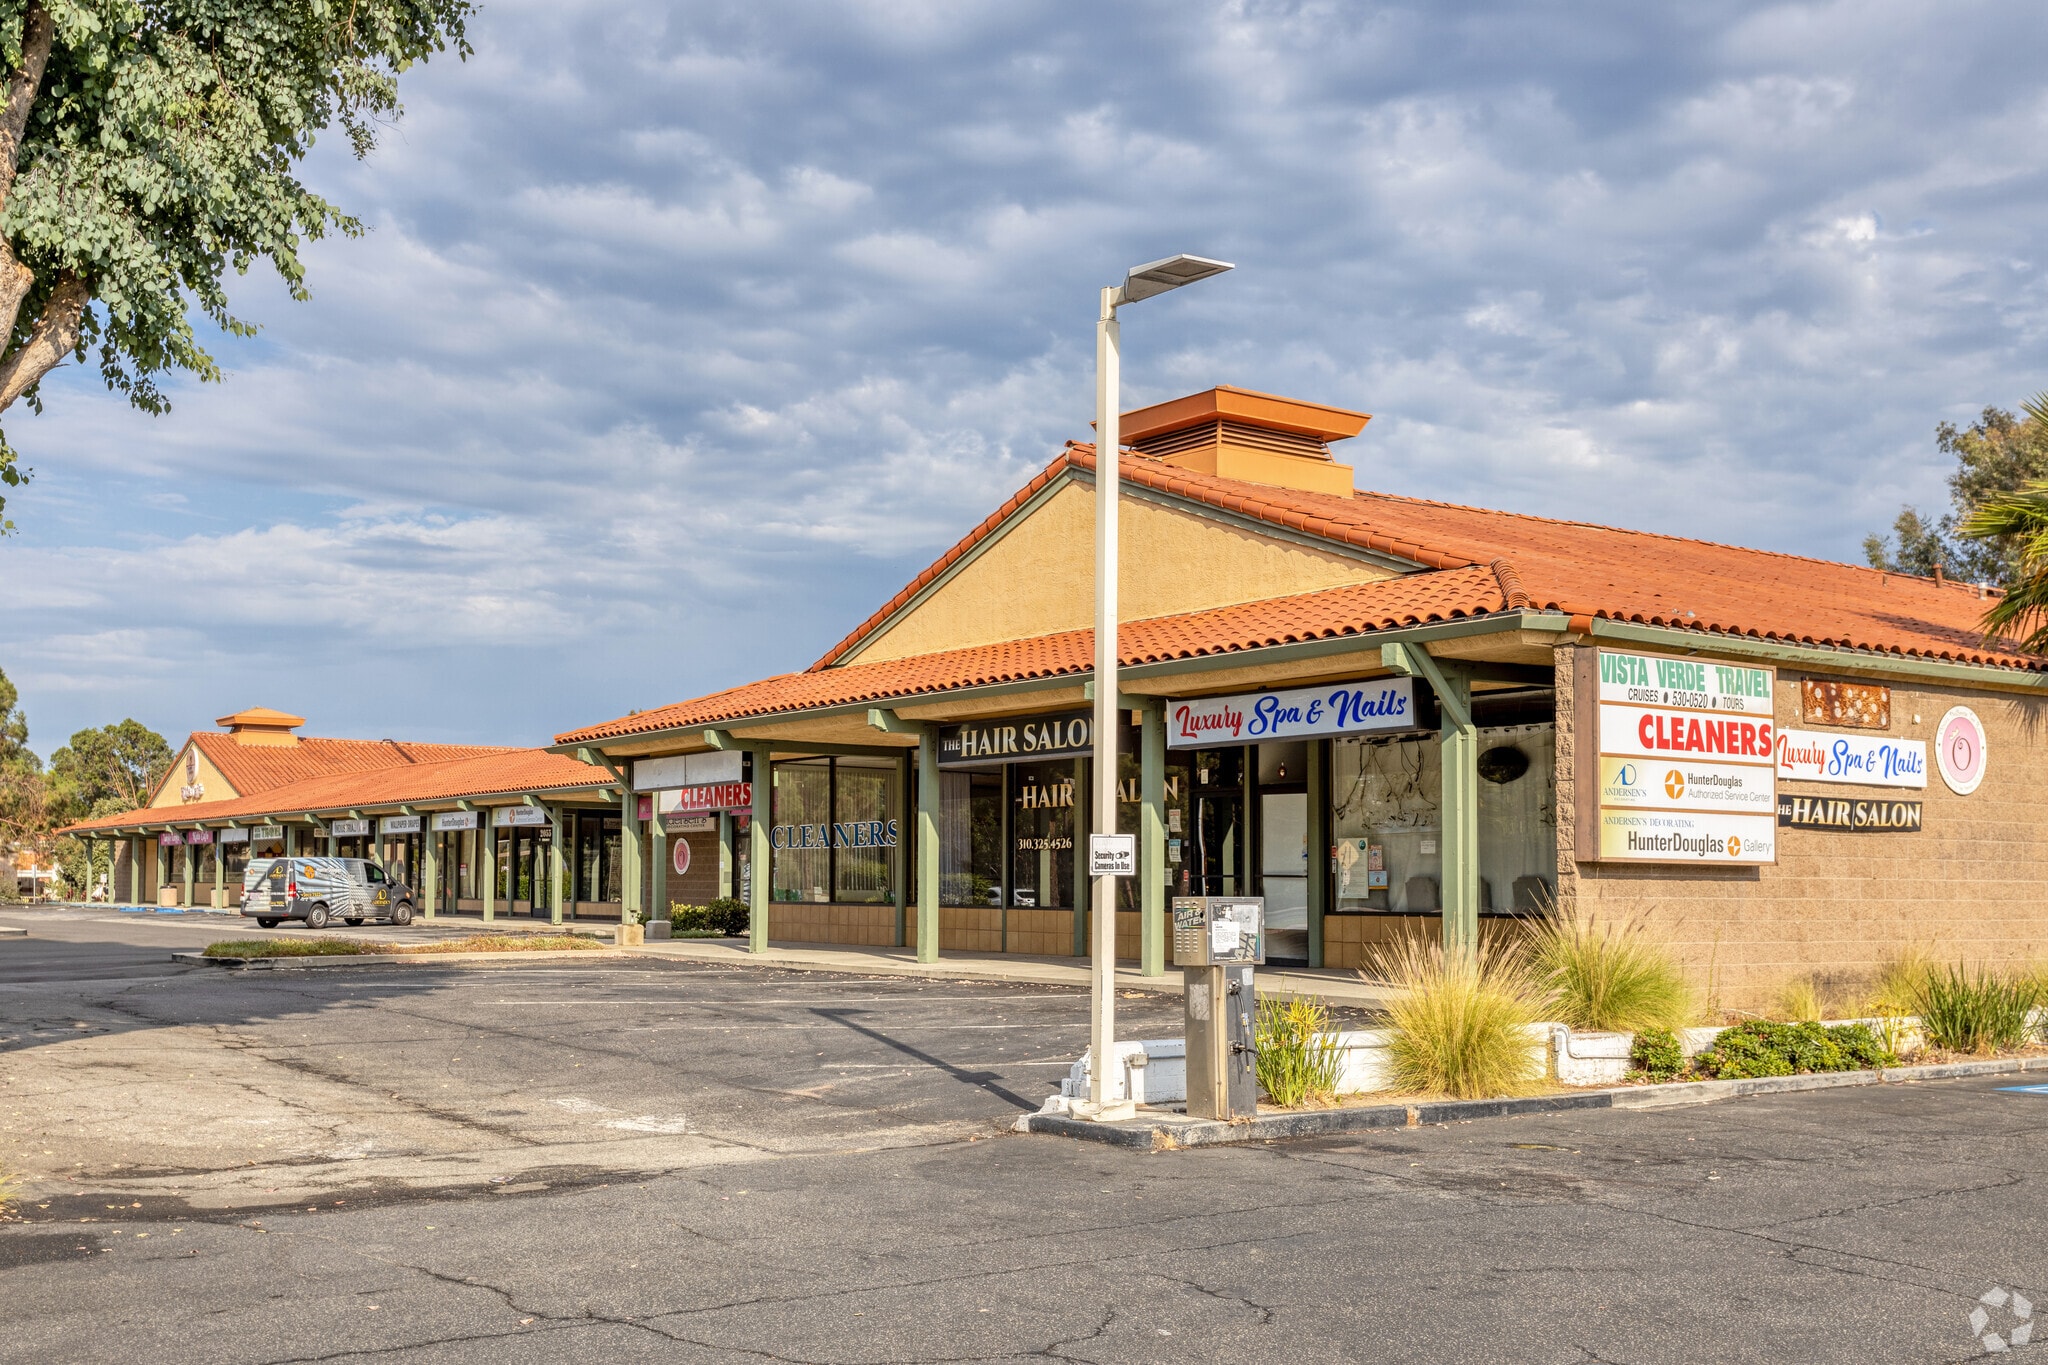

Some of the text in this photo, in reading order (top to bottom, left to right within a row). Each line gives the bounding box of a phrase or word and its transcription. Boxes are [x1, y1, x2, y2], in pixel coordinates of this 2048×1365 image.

[1600, 653, 1770, 698] VISTA VERDE TRAVEL
[1628, 688, 1745, 710] CRUISES 530-0520 TOURS
[1175, 689, 1407, 739] Luxury Spa & Nails
[943, 739, 961, 751] THE
[961, 726, 1019, 757] HAIR
[1638, 713, 1772, 757] CLEANERS
[1777, 734, 1923, 779] Luxury Spa & Nails
[1022, 775, 1179, 809] HAIR ALN
[1603, 787, 1647, 797] ANDERSEN'S
[1687, 772, 1743, 789] HunterDouglas
[680, 784, 751, 810] CLEANERS
[1688, 788, 1771, 803] Authorized Service Center
[1603, 816, 1695, 828] ANDERSEN'S DECORATING
[1778, 797, 1922, 827] HE HAIR SALON
[770, 819, 897, 849] CLEANERS
[1017, 838, 1073, 850] 310.325.4526
[1628, 830, 1770, 857] HunterDouglas Gallery
[1095, 851, 1114, 861] Security
[1095, 861, 1130, 870] Cameras In Use
[1174, 915, 1206, 930] WATER
[1178, 910, 1194, 922] AIR
